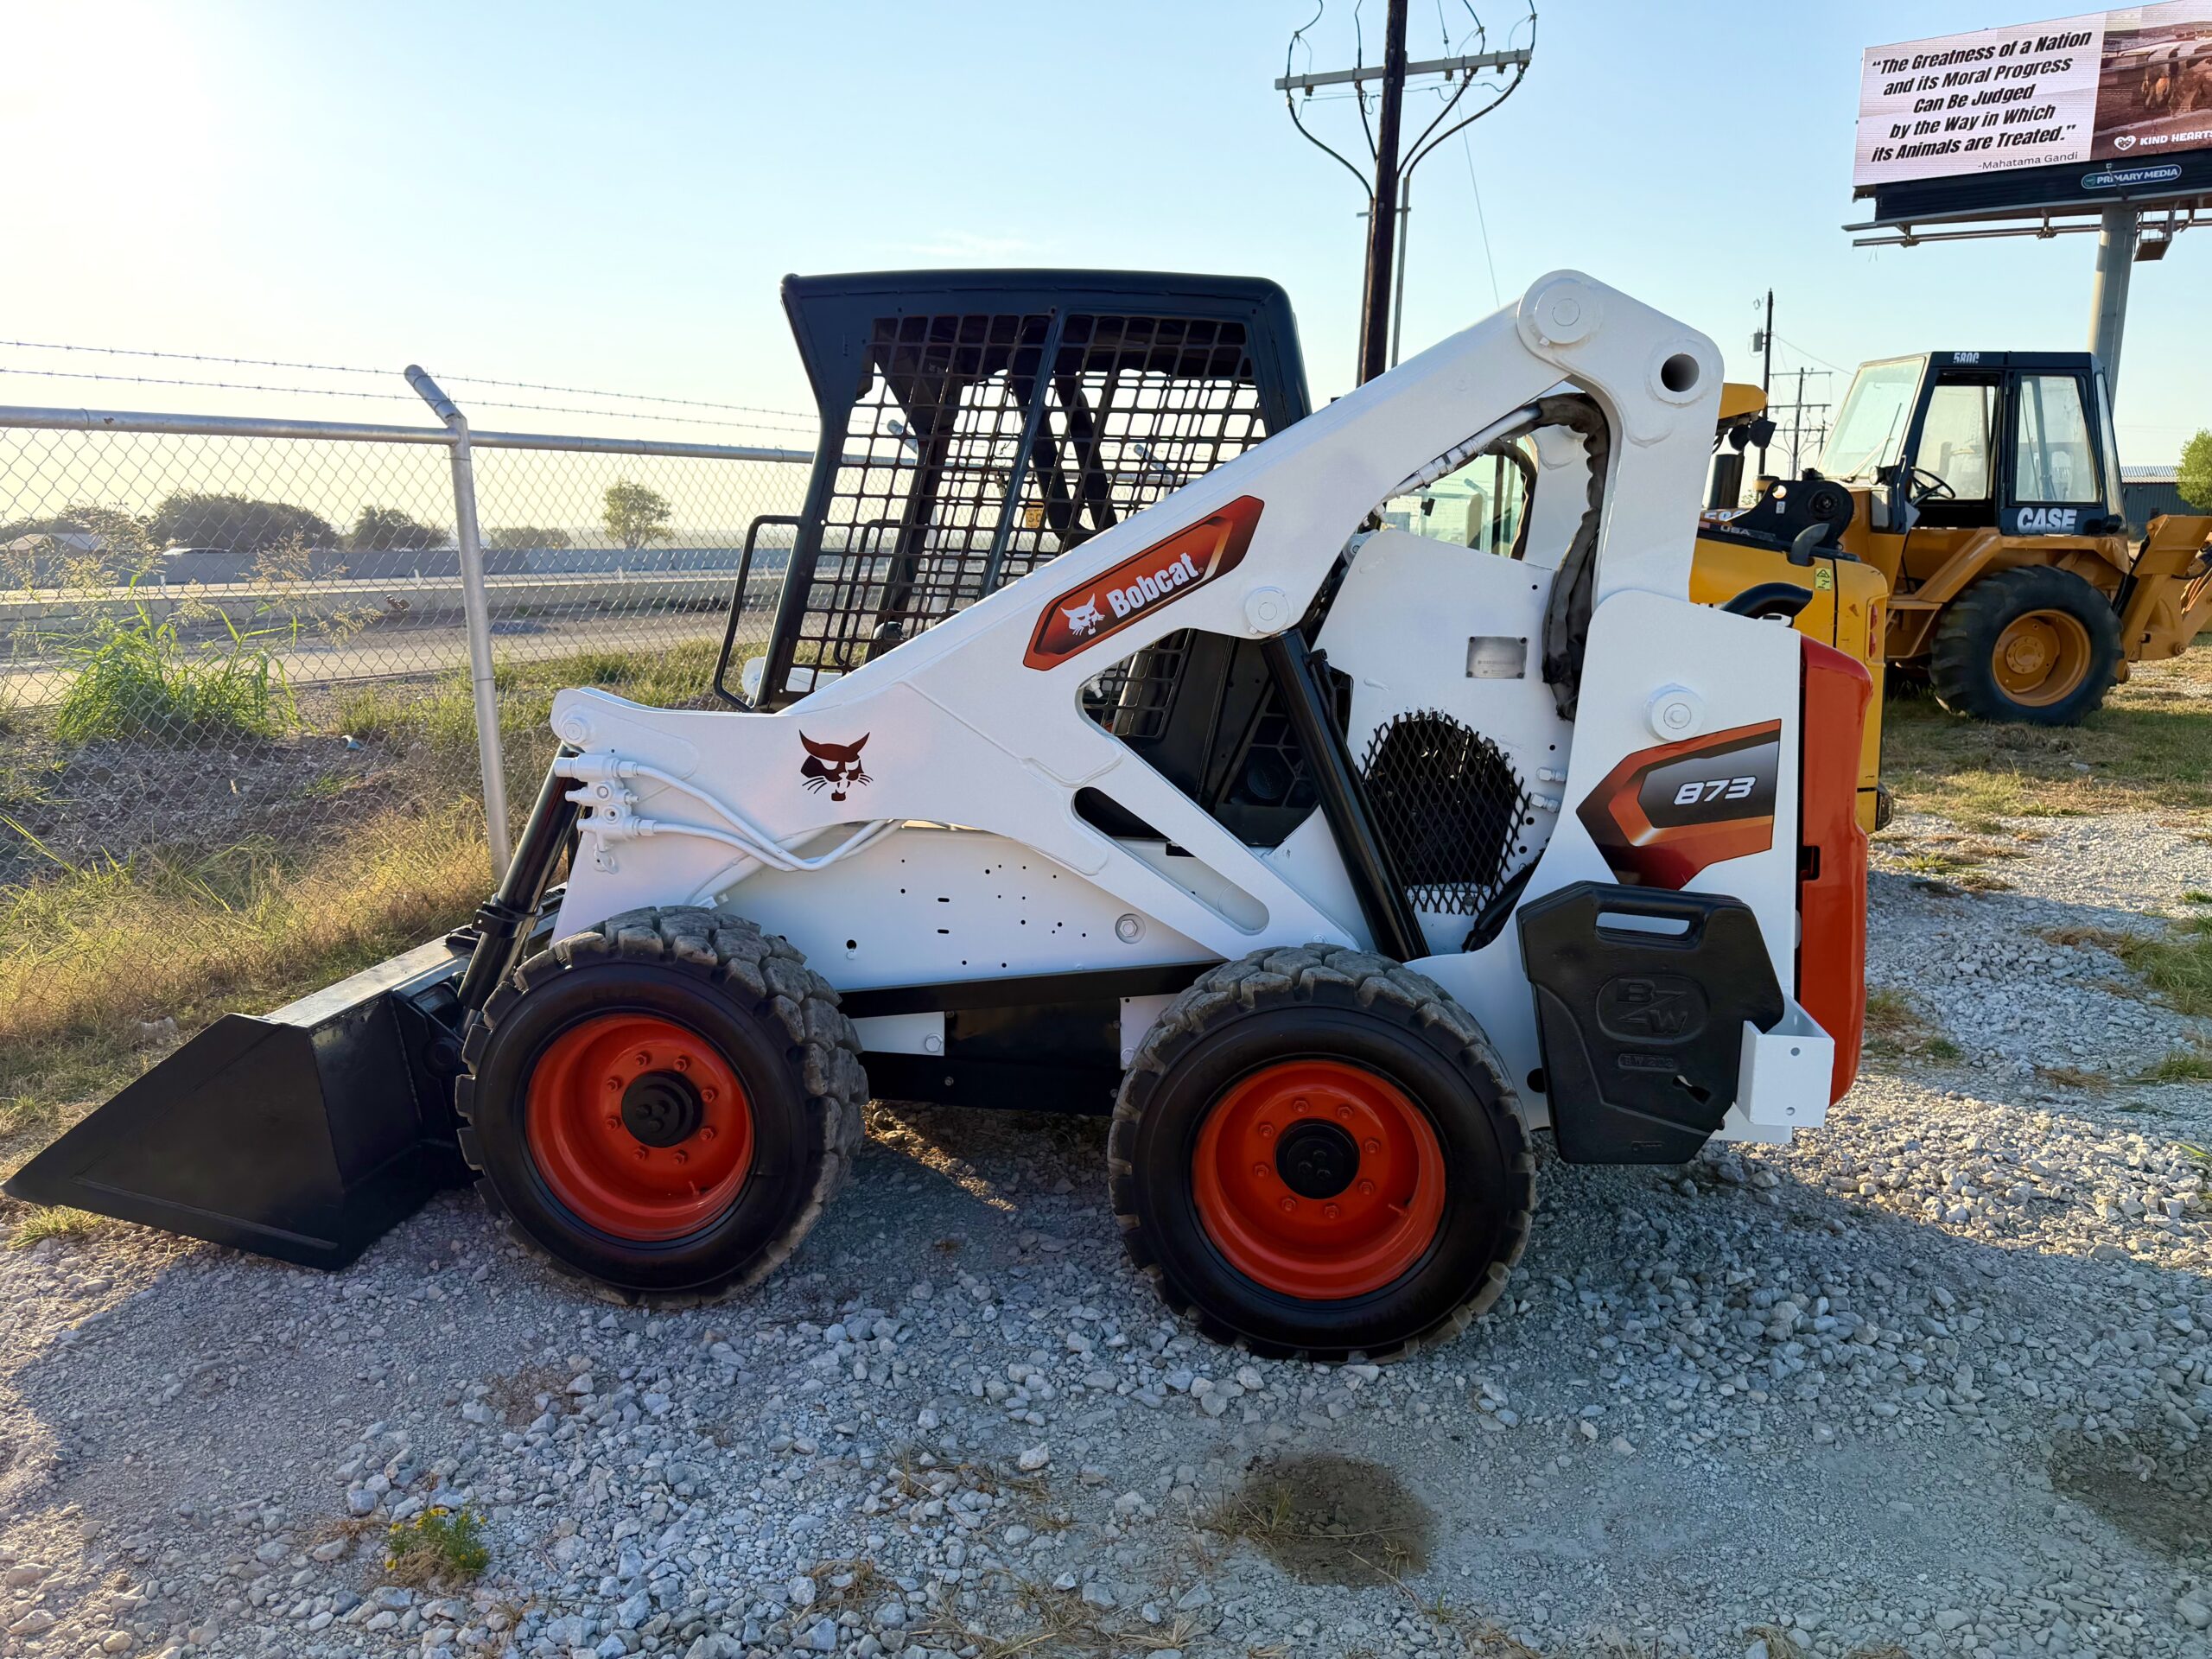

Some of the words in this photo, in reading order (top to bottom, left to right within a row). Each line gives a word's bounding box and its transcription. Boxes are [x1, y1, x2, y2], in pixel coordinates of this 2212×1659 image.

[1911, 45, 1995, 70] Greatness
[1999, 40, 2020, 58] of
[2019, 40, 2032, 54] a
[2034, 30, 2093, 53] Nation
[1883, 77, 1914, 95] and
[1916, 73, 1940, 92] its
[1942, 66, 1993, 88] Moral
[1993, 56, 2074, 81] Progress
[1913, 95, 1944, 113] Can
[1947, 93, 1969, 110] Be
[1971, 84, 2037, 106] Judged
[1889, 123, 1910, 140] by
[1913, 119, 1940, 136] the
[1944, 114, 1981, 133] Way
[1981, 111, 1999, 127] in
[2003, 104, 2056, 124] Which
[1871, 146, 1894, 162] its
[1896, 138, 1961, 159] Animals
[1964, 136, 1992, 152] are
[2139, 135, 2169, 146] KIND
[1978, 156, 2042, 170] -Mahatama
[2044, 151, 2079, 163] Gandi
[2144, 168, 2178, 180] MEDIA
[1720, 524, 1751, 536] USA
[2017, 506, 2077, 534] CASE
[1106, 552, 1199, 619] Bobcat
[1674, 776, 1756, 805] 873
